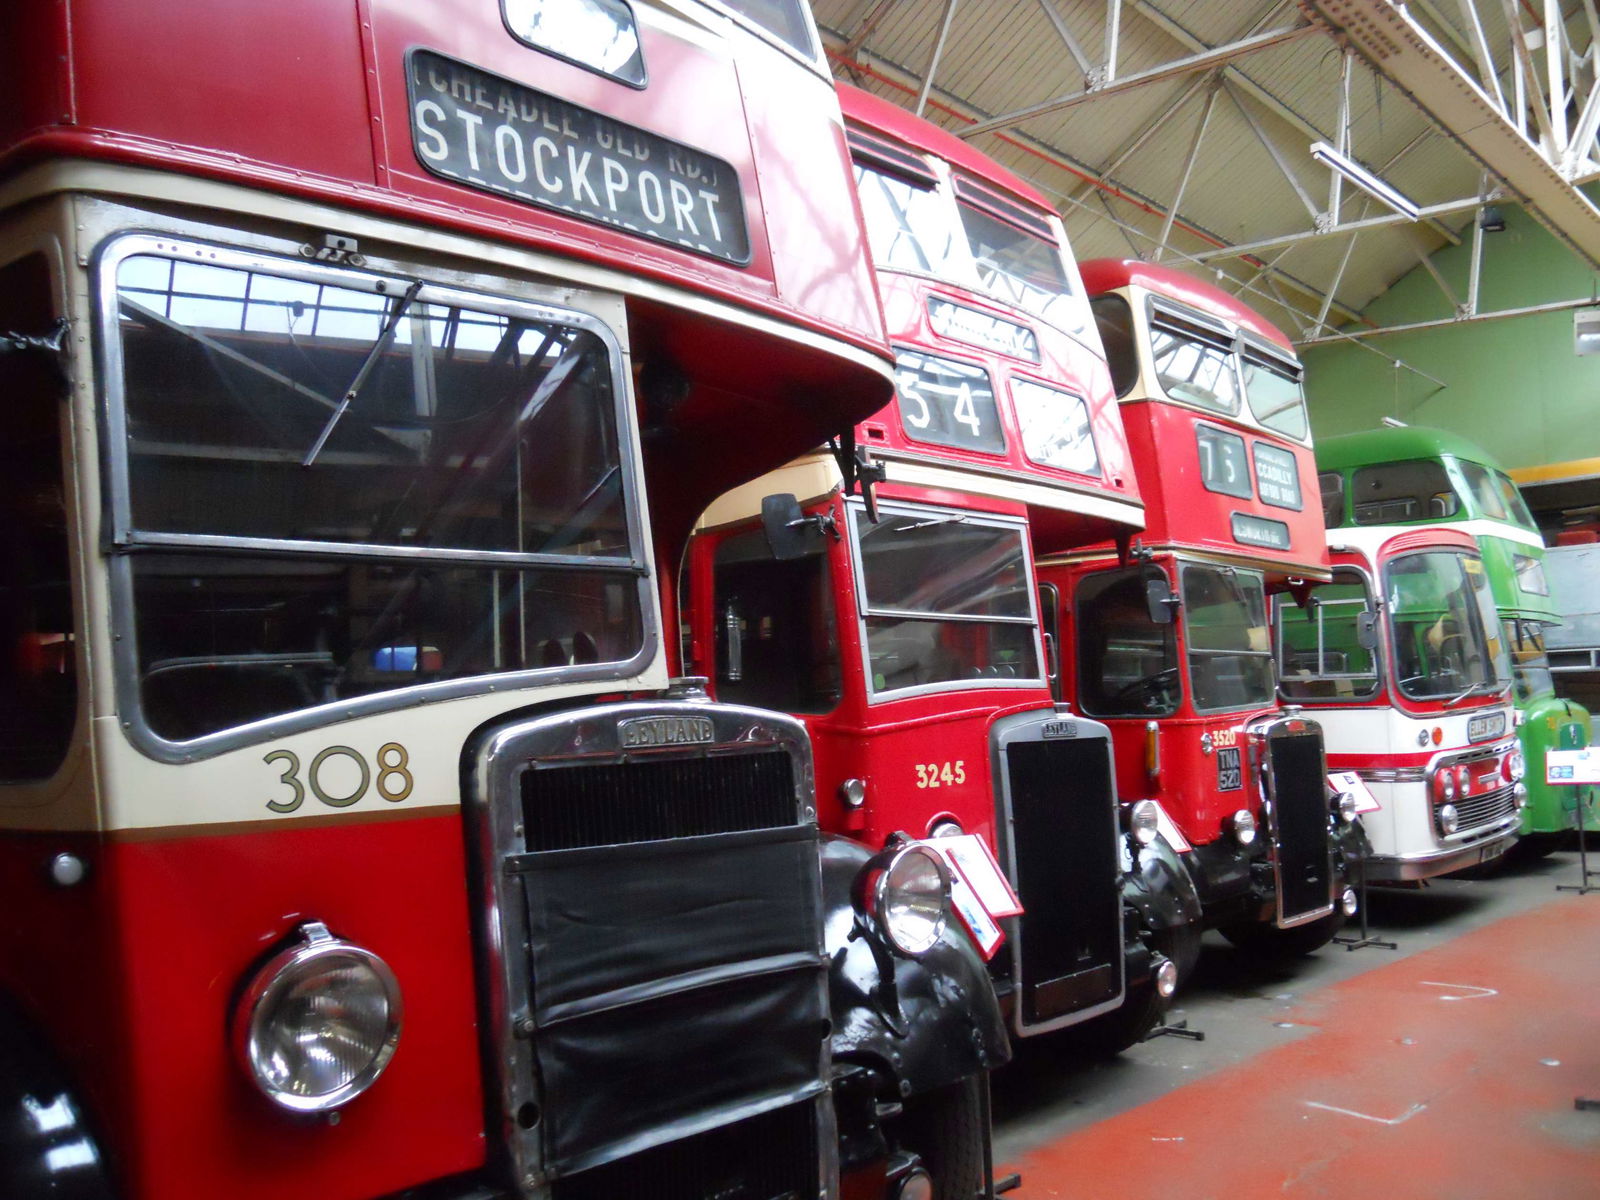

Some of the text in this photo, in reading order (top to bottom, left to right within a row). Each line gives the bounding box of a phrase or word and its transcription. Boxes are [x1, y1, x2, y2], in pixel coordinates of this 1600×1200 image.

[414, 99, 722, 242] STOCKPORT
[622, 719, 712, 745] LEYLAND
[1212, 730, 1236, 746] 3520
[263, 741, 414, 814] 308
[915, 760, 966, 788] 3245
[1220, 769, 1241, 788] 520
